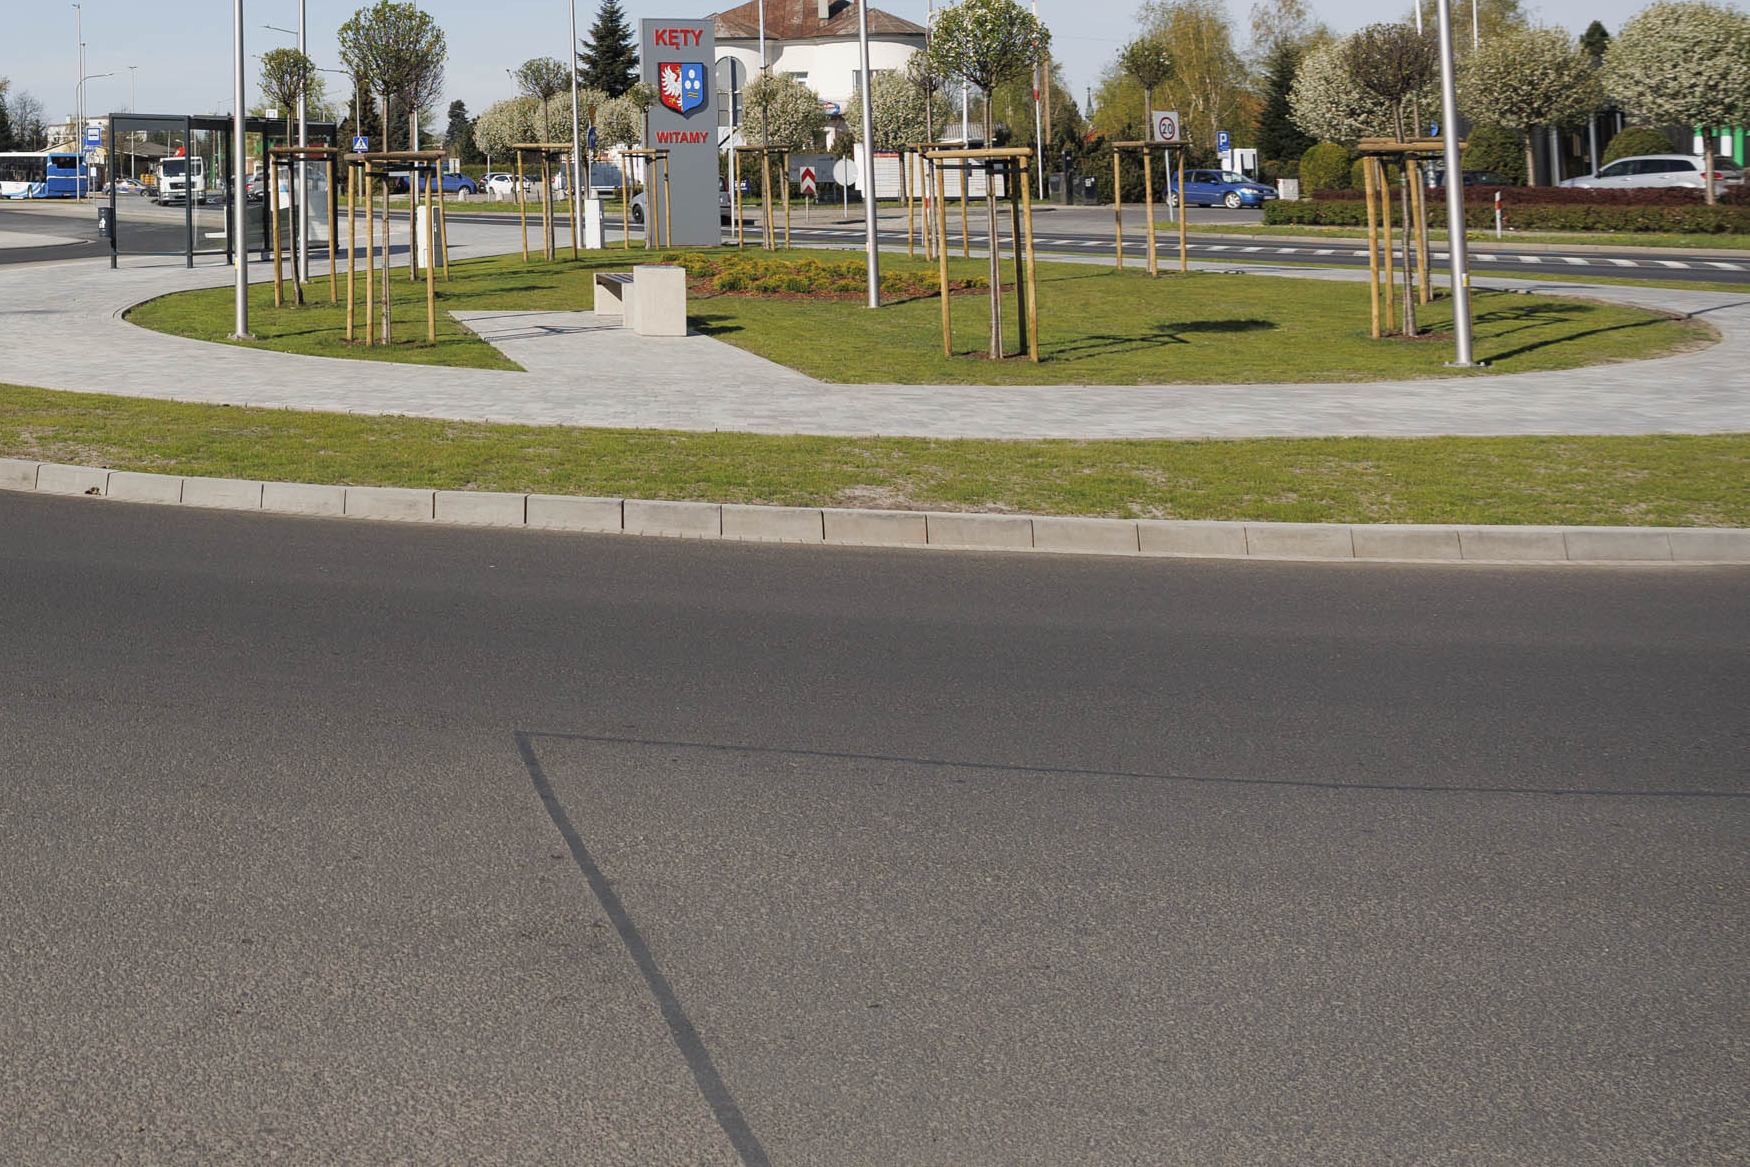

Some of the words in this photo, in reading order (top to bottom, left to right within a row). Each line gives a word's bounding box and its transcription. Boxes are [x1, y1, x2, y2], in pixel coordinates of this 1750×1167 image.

[654, 29, 703, 50] KĘTY
[1162, 122, 1173, 135] 20
[656, 130, 709, 144] WITAMY
[1220, 133, 1227, 145] P
